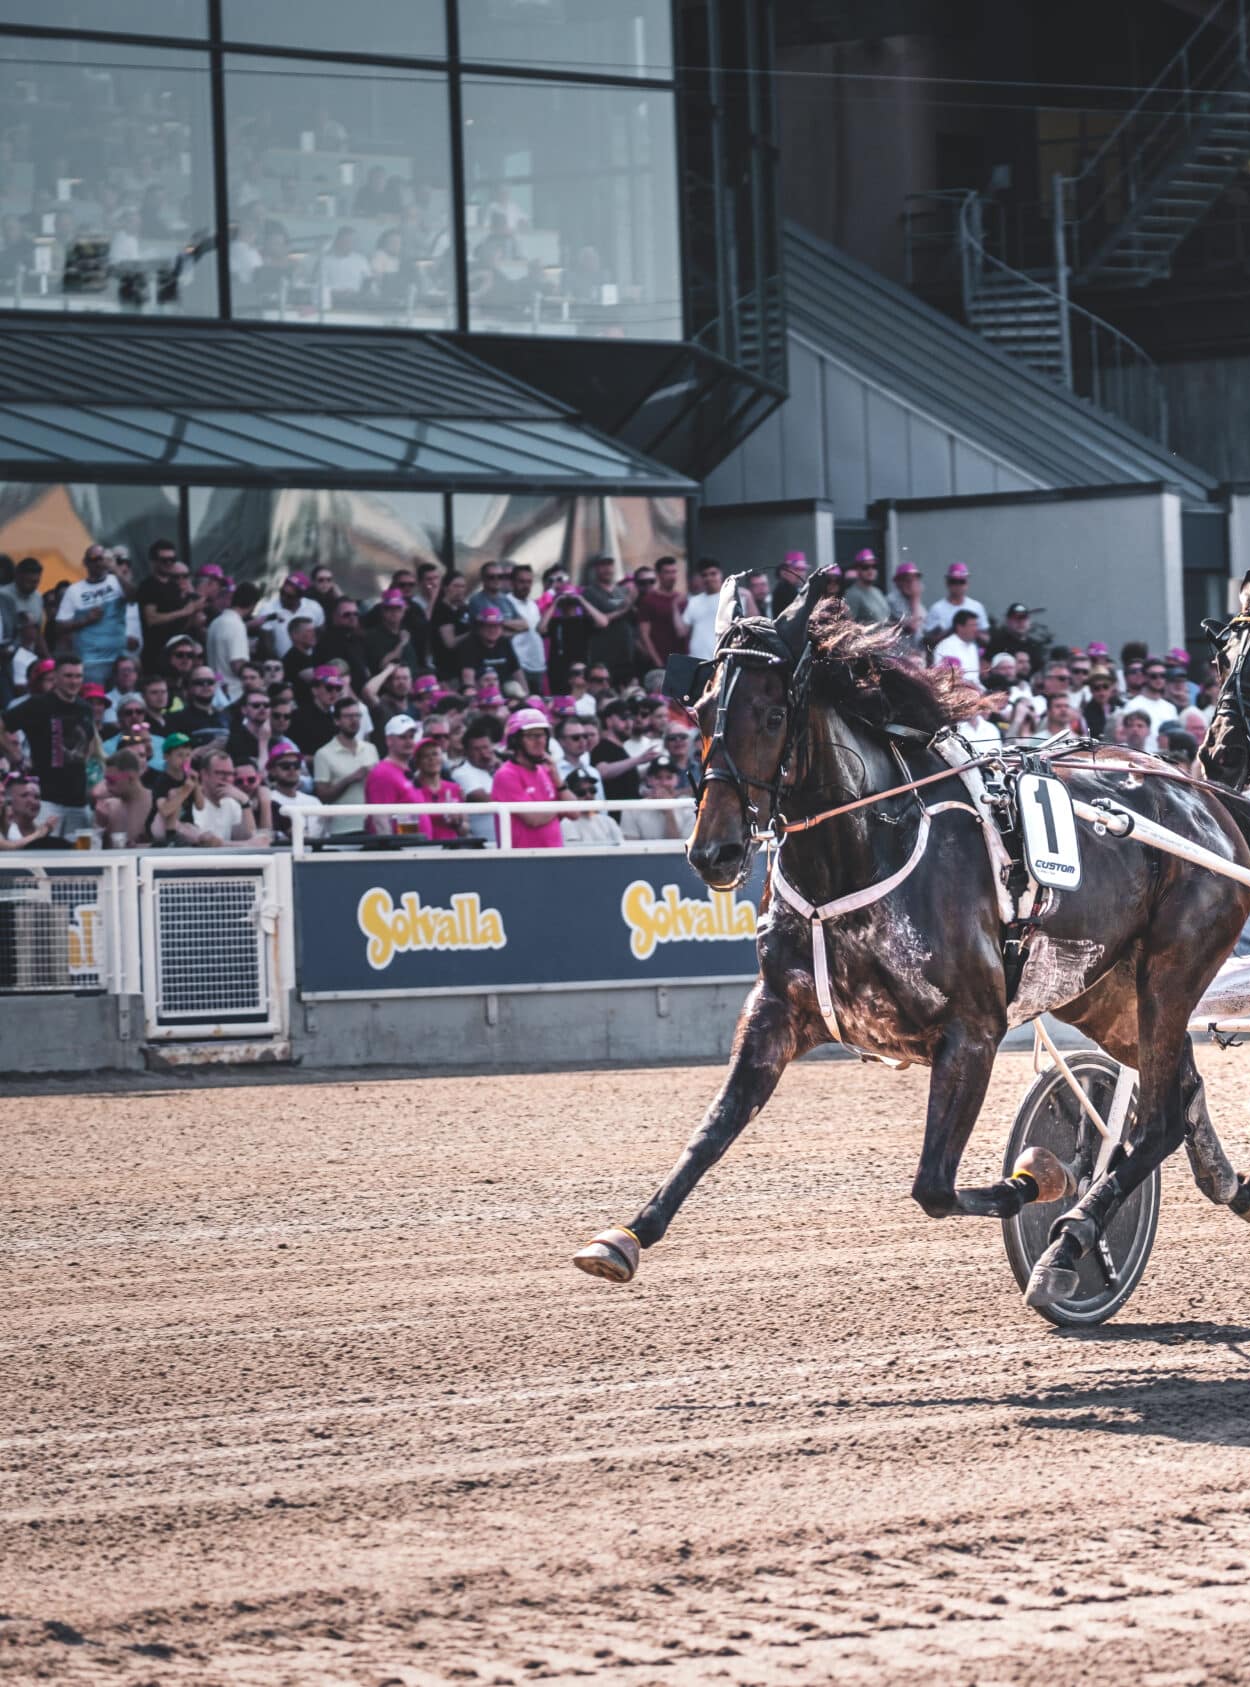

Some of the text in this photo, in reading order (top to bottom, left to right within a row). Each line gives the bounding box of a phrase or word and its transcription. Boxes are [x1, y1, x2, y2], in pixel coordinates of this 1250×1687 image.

[1034, 779, 1059, 854] 1
[1035, 860, 1075, 874] CUSTOM
[360, 890, 503, 967] Solvalla
[624, 882, 757, 958] Solvalla
